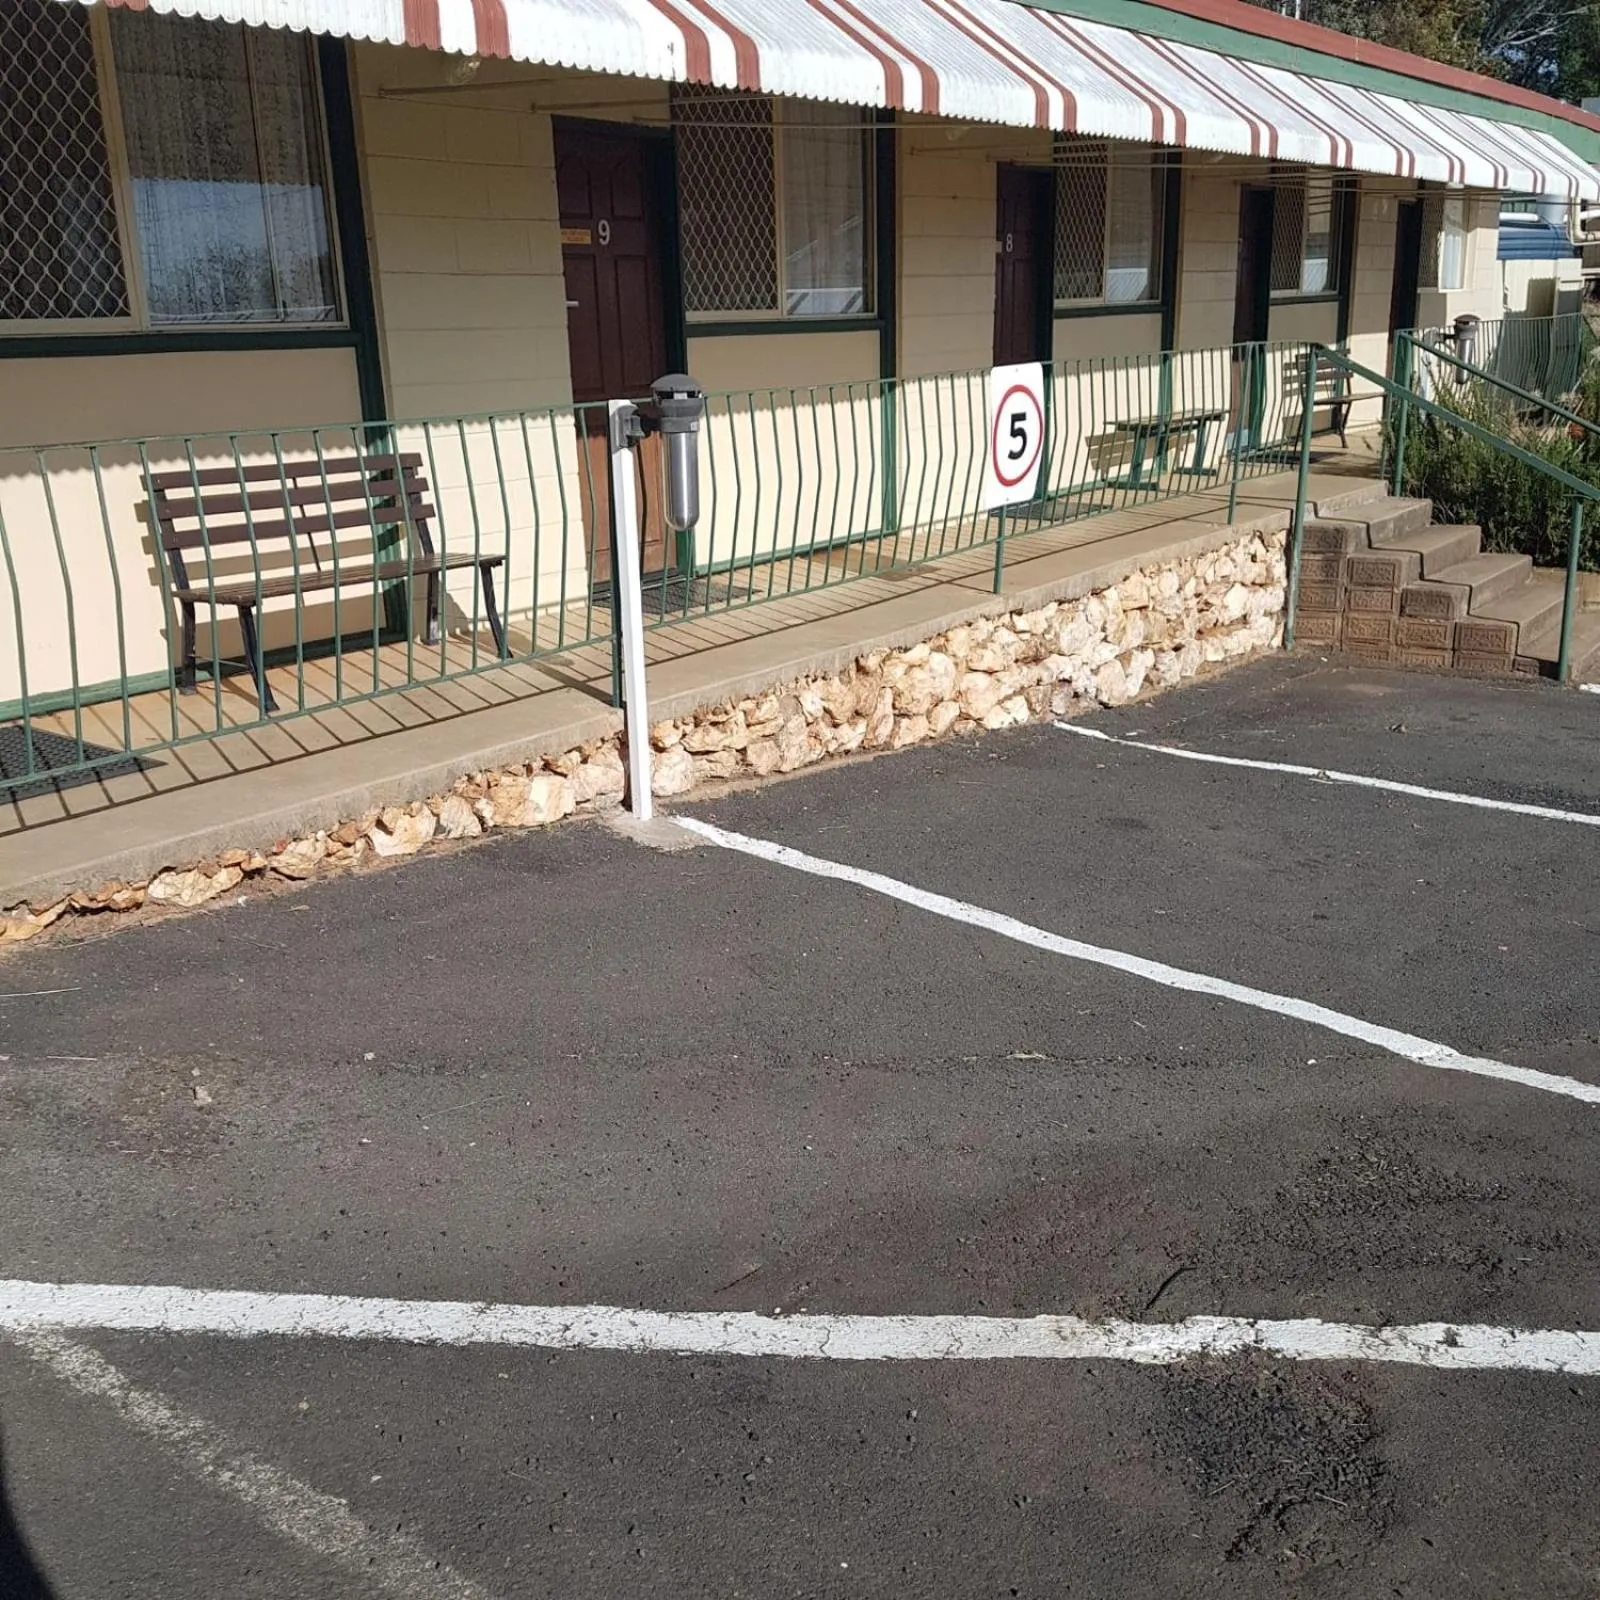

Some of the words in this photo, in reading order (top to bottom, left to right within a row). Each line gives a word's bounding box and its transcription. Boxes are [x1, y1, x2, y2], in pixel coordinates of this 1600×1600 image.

[598, 219, 610, 245] 9
[1006, 233, 1013, 252] 8
[1007, 411, 1028, 461] 5
